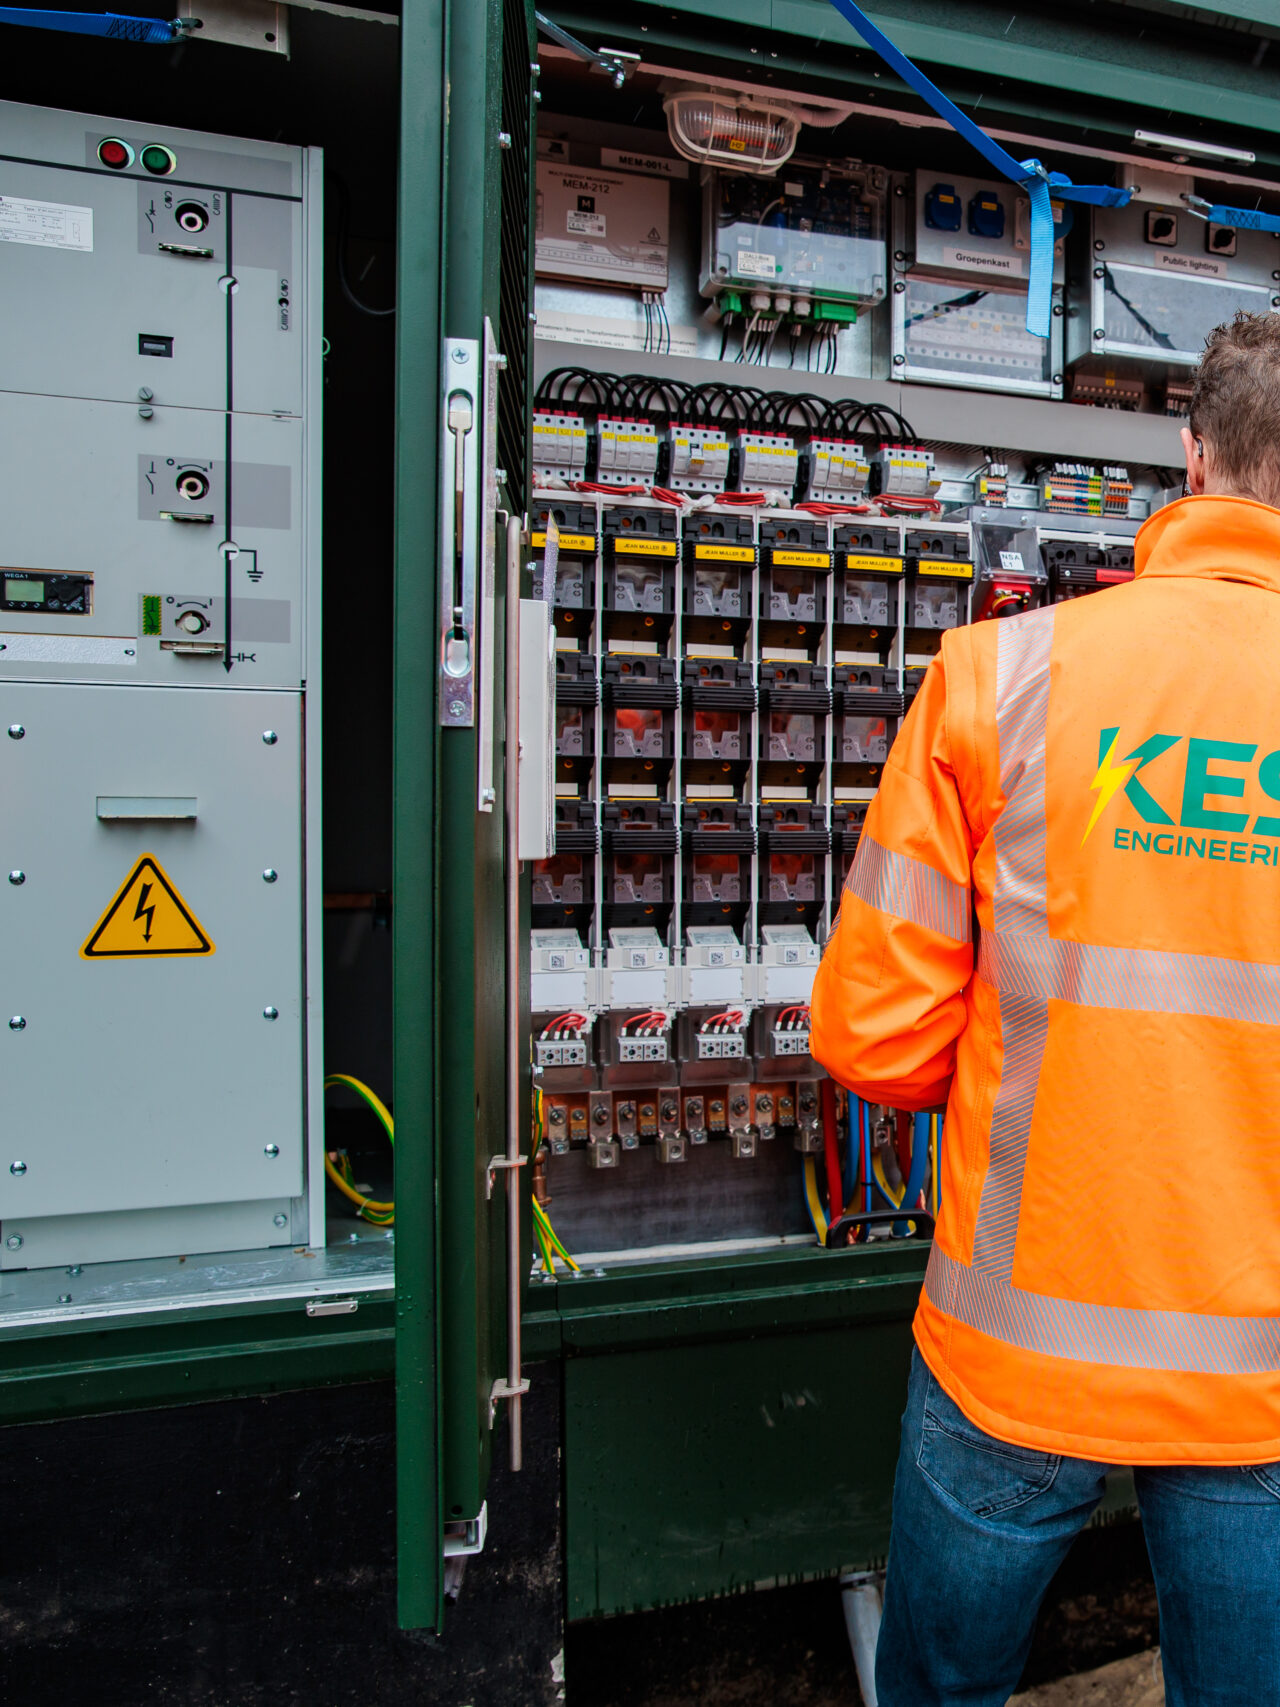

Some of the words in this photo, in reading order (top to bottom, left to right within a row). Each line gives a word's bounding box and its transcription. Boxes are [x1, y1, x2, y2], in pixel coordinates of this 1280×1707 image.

[619, 156, 672, 171] MEM-001-L
[562, 179, 611, 193] MEM-212
[956, 253, 1010, 269] Groepenkast
[1163, 255, 1188, 267] Public
[1189, 260, 1219, 273] lighting
[1002, 553, 1021, 561] NSA
[658, 951, 664, 960] 2
[735, 950, 740, 958] 3
